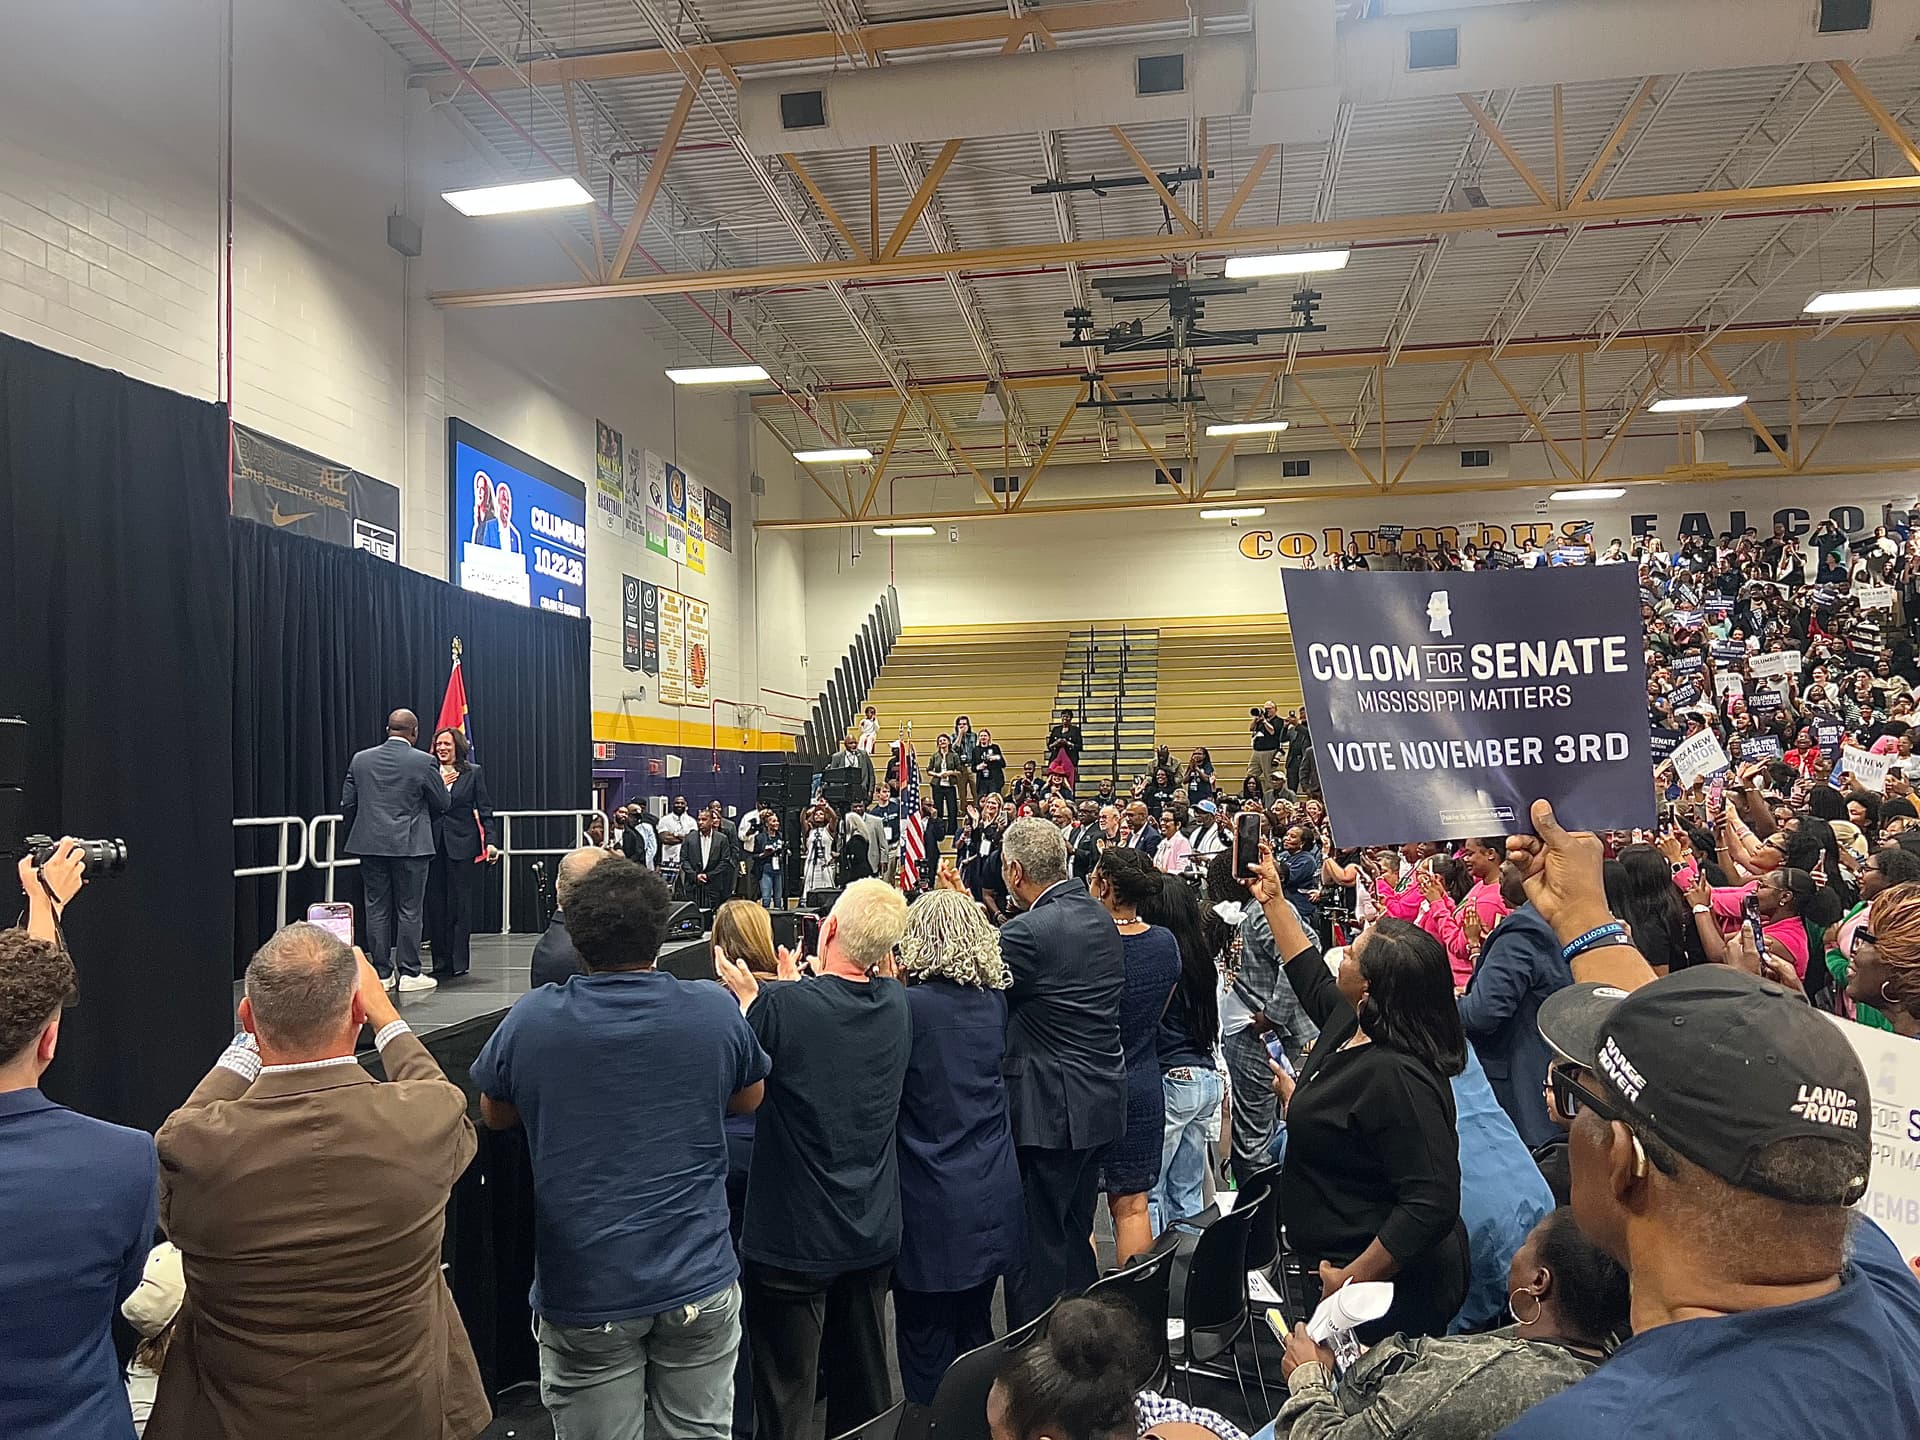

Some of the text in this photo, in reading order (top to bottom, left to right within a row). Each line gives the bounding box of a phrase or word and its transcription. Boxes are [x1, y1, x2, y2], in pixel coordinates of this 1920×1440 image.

[531, 506, 585, 549] COLUMBUS
[1308, 636, 1629, 681] COLOM FOR SENATE
[1356, 684, 1572, 713] MISSISSIPPI MATTERS
[1327, 741, 1397, 772] VOTE
[1400, 736, 1543, 771] NOVEMBER
[1554, 732, 1630, 763] 3RD
[1675, 751, 1688, 765] PICK
[1692, 735, 1711, 752] NEW
[1679, 744, 1718, 775] SENATOR
[1864, 758, 1885, 769] NEW
[1598, 1047, 1640, 1103] ROVER
[1797, 1084, 1847, 1108] LAND
[1802, 1102, 1858, 1129] ROVER
